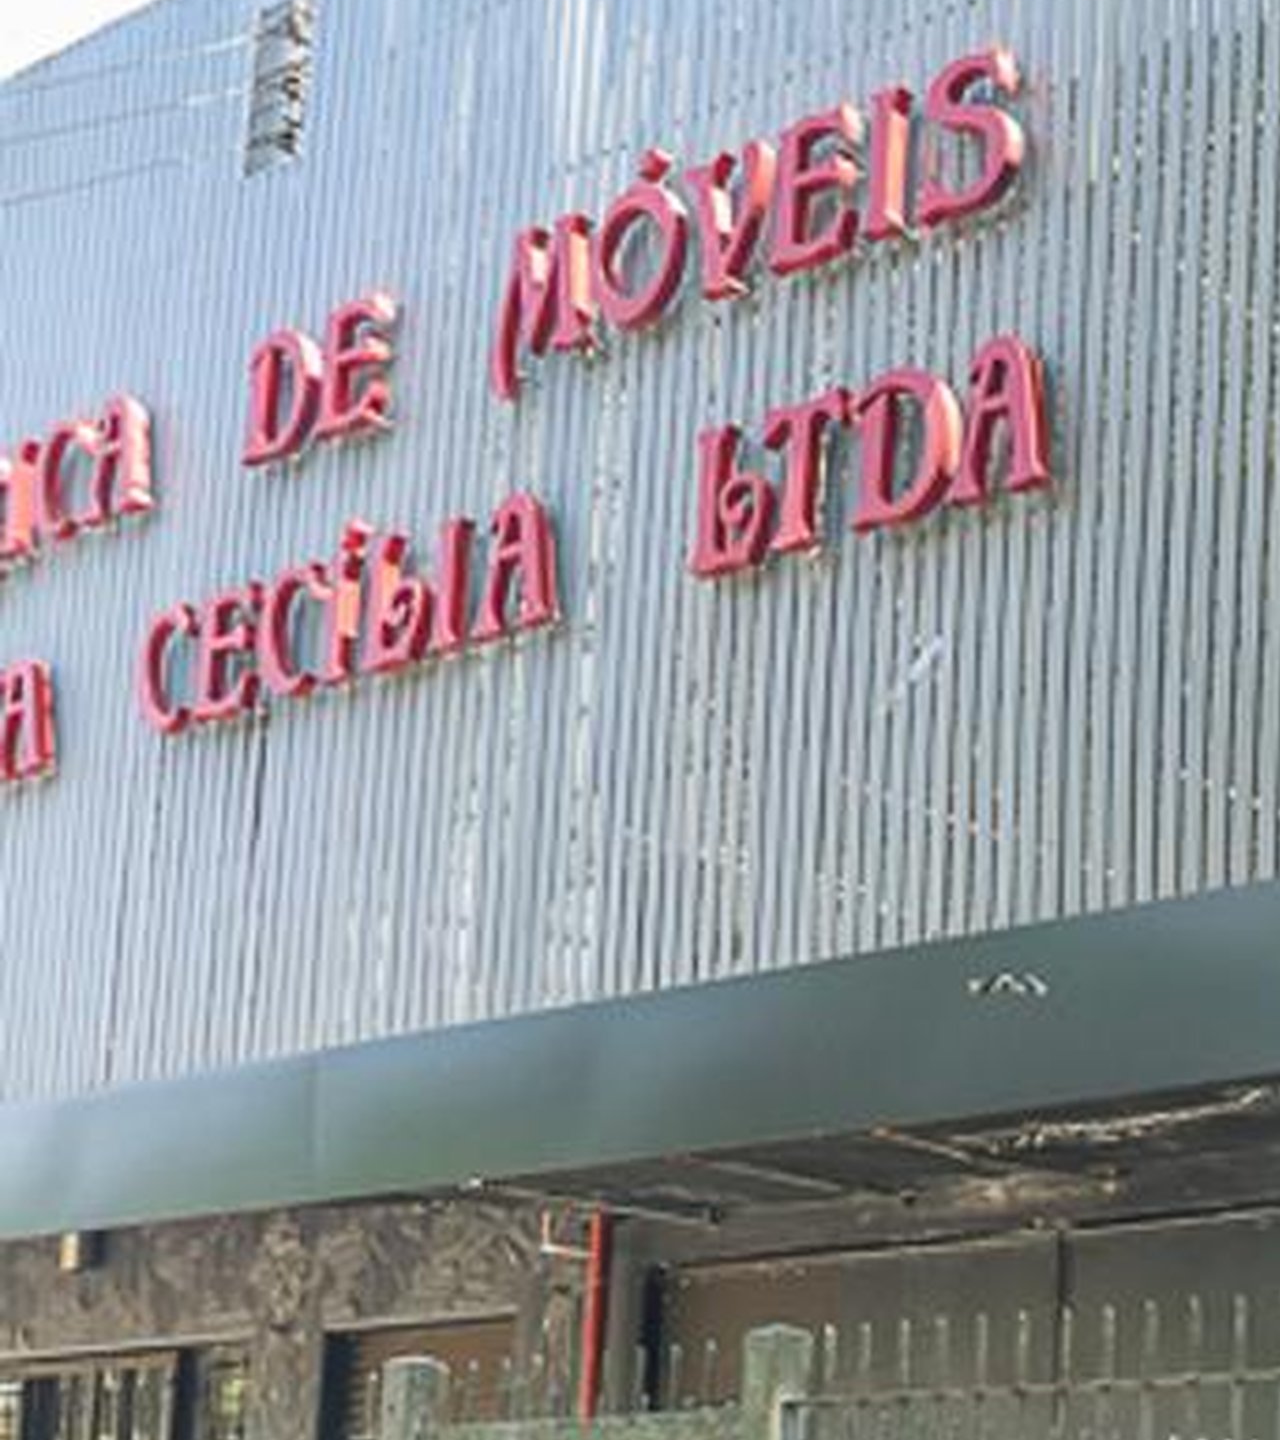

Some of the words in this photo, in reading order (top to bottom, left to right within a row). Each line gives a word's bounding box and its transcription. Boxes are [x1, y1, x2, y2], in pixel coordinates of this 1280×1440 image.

[242, 292, 398, 466] DE
[493, 46, 1026, 402] MÓVEIS
[690, 334, 1050, 579] LTDA
